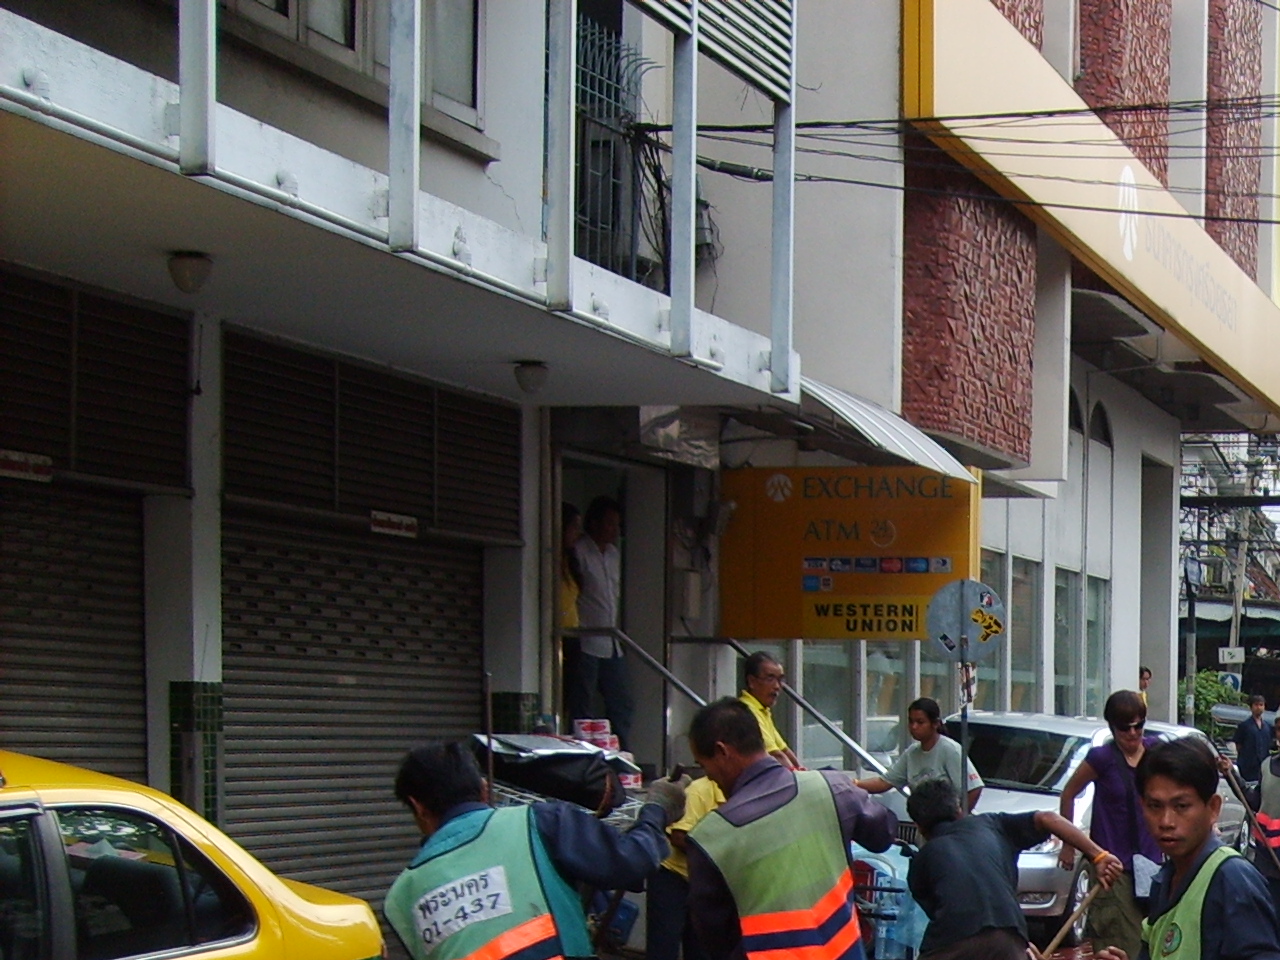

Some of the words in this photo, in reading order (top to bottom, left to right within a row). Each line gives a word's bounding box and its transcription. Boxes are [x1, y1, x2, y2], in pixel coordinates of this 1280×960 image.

[803, 474, 954, 499] EXCHANGE
[803, 519, 861, 541] ATM
[814, 603, 914, 617] WESTERN
[846, 618, 914, 632] UNION
[418, 873, 491, 919] พระนคร
[421, 892, 502, 944] 01-437
